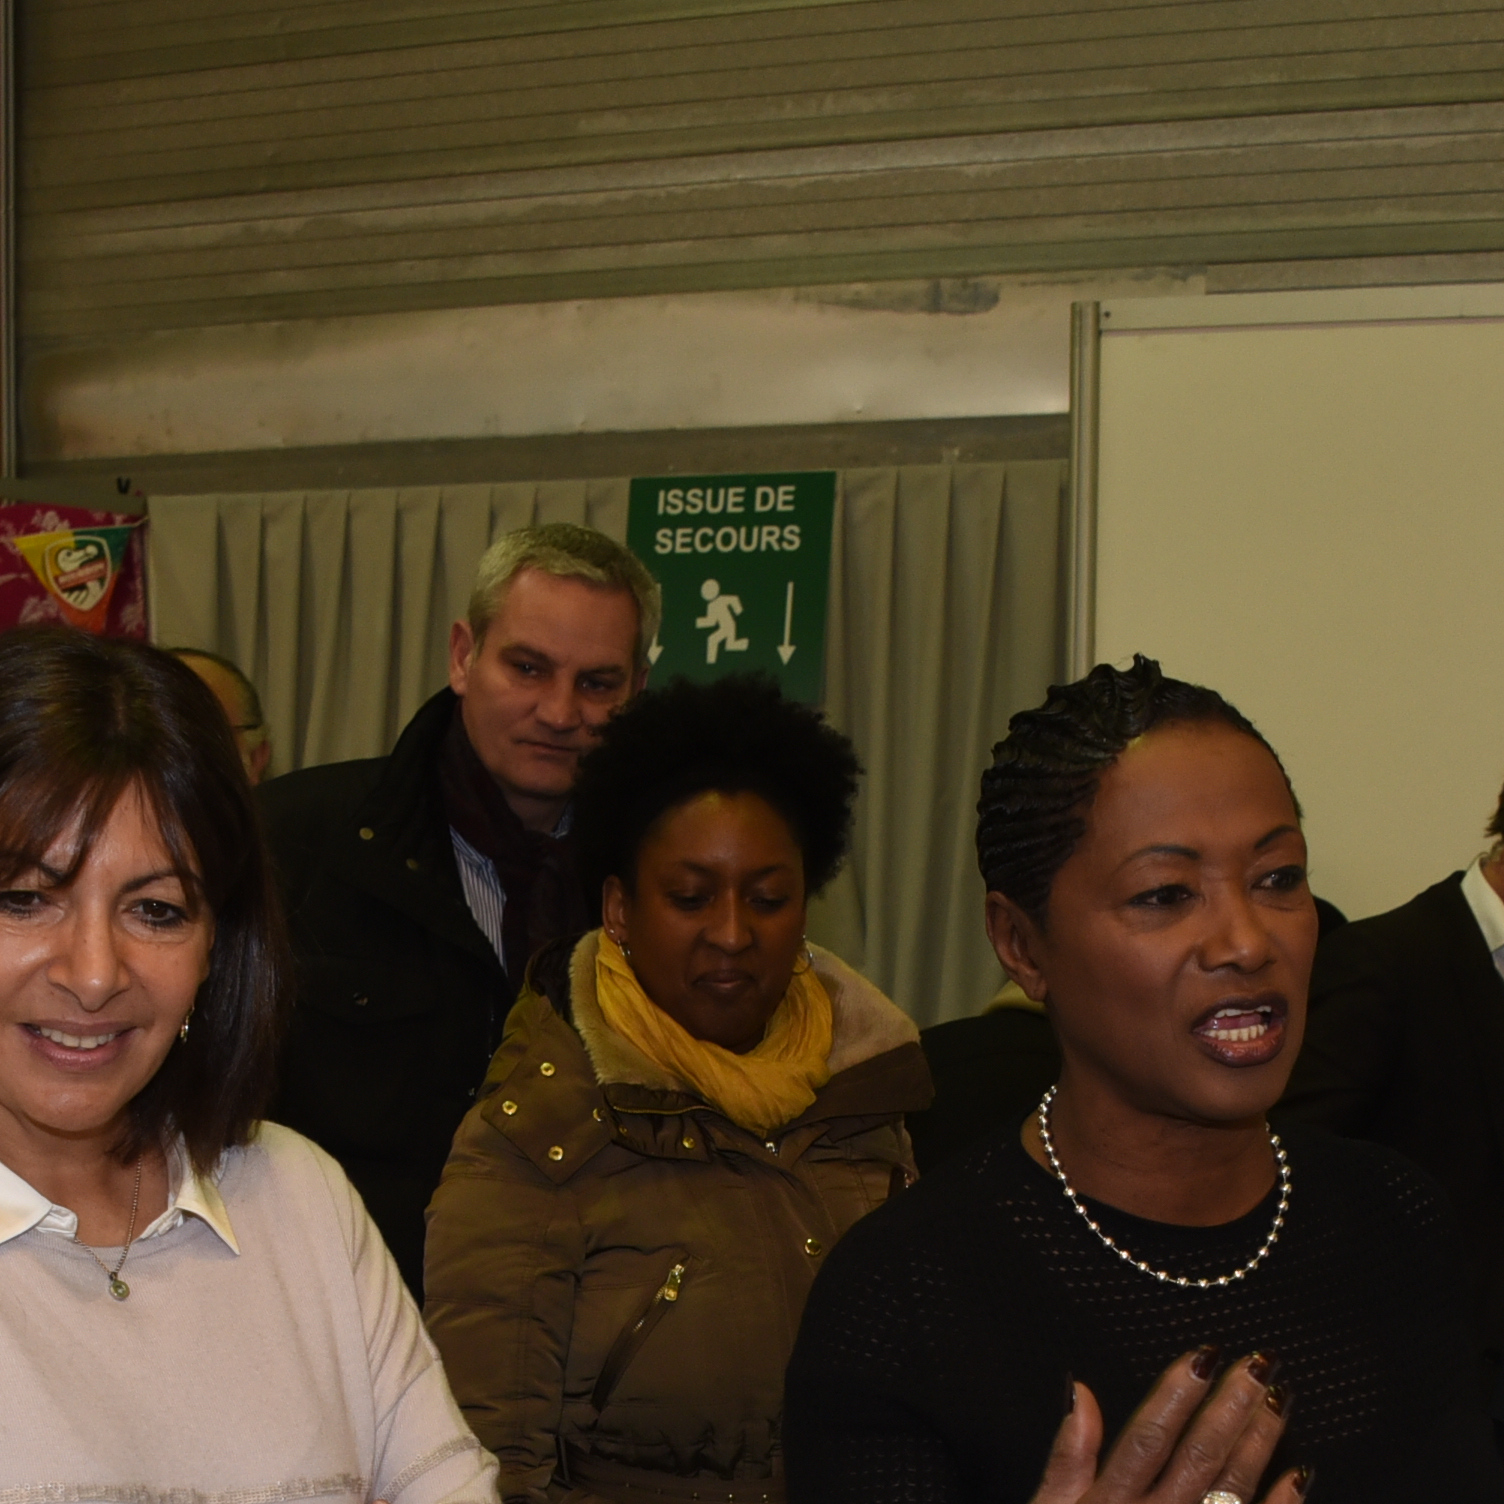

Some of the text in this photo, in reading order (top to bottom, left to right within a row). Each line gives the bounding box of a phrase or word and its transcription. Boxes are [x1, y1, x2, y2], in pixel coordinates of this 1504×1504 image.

[657, 484, 796, 516] ISSUE DE
[654, 524, 801, 554] SECOURS
